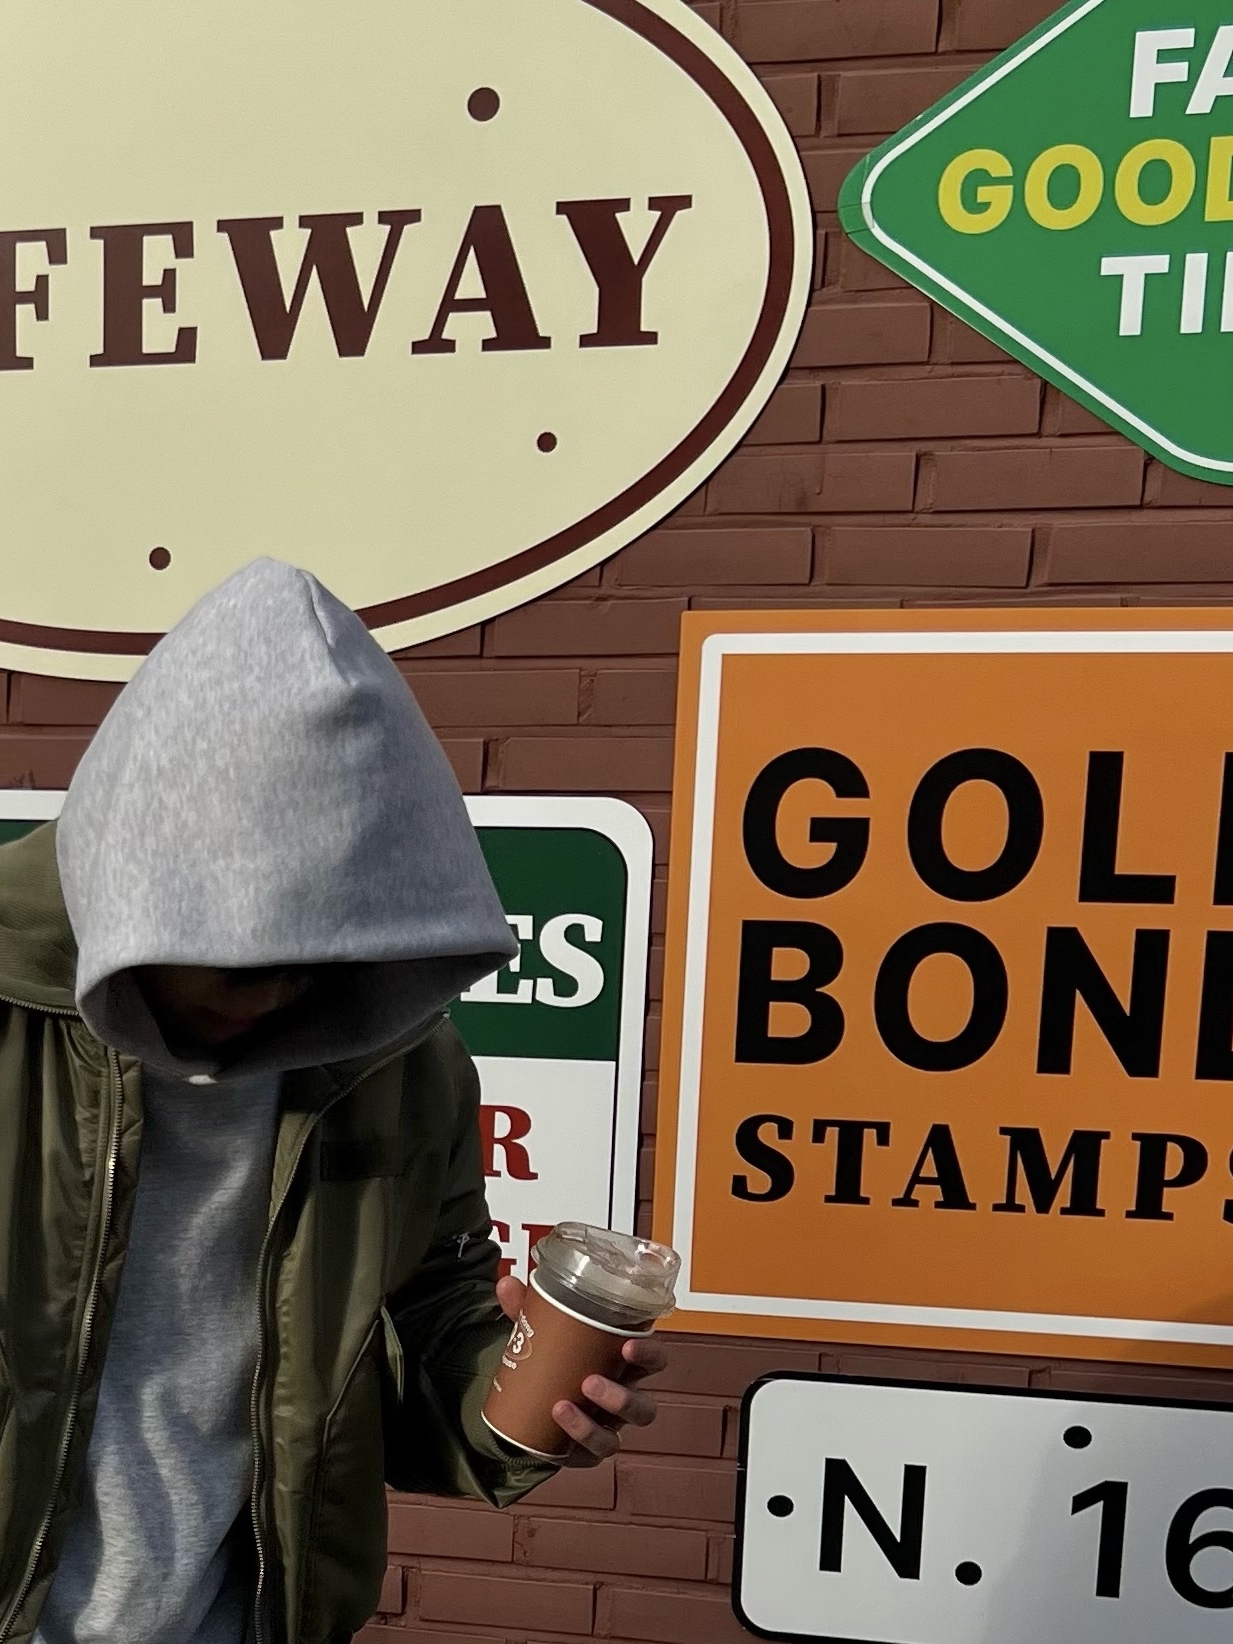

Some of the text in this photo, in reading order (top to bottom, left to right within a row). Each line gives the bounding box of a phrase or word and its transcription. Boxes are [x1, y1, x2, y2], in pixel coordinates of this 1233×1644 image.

[1099, 251, 1233, 336] TI
[741, 745, 1233, 907] GOL
[730, 1112, 1233, 1225] STAMP
[1070, 1479, 1233, 1610] 16
